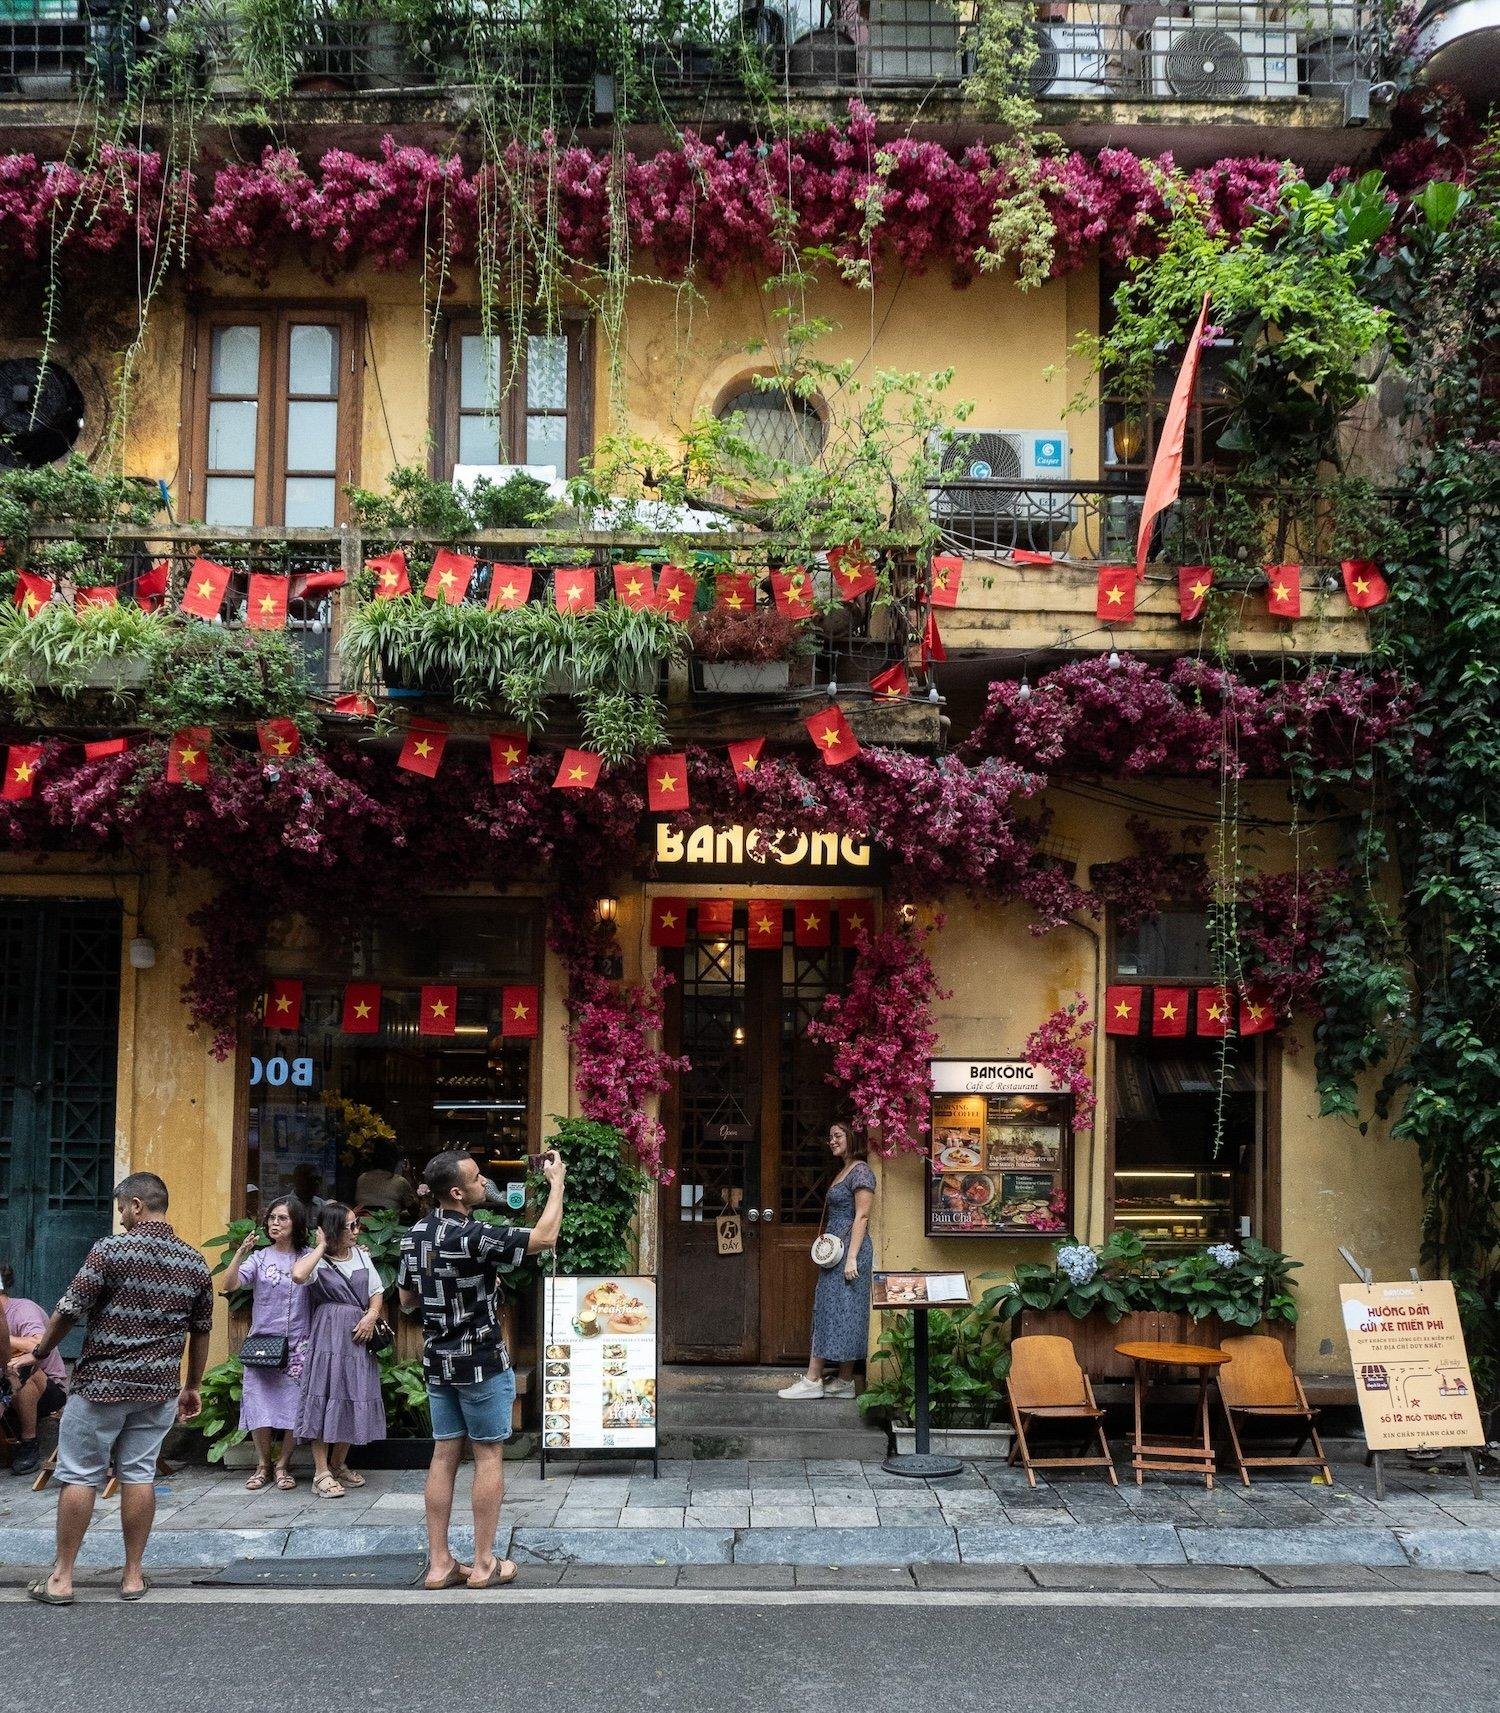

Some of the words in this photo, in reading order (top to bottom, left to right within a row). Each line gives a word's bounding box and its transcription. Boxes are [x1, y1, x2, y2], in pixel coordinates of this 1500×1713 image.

[1037, 457, 1060, 466] Casper
[996, 1082, 1039, 1091] Restaurant
[720, 1124, 738, 1140] Open
[1381, 1321, 1394, 1331] XE
[1393, 1413, 1403, 1422] 12
[1424, 1413, 1446, 1421] TRUNG
